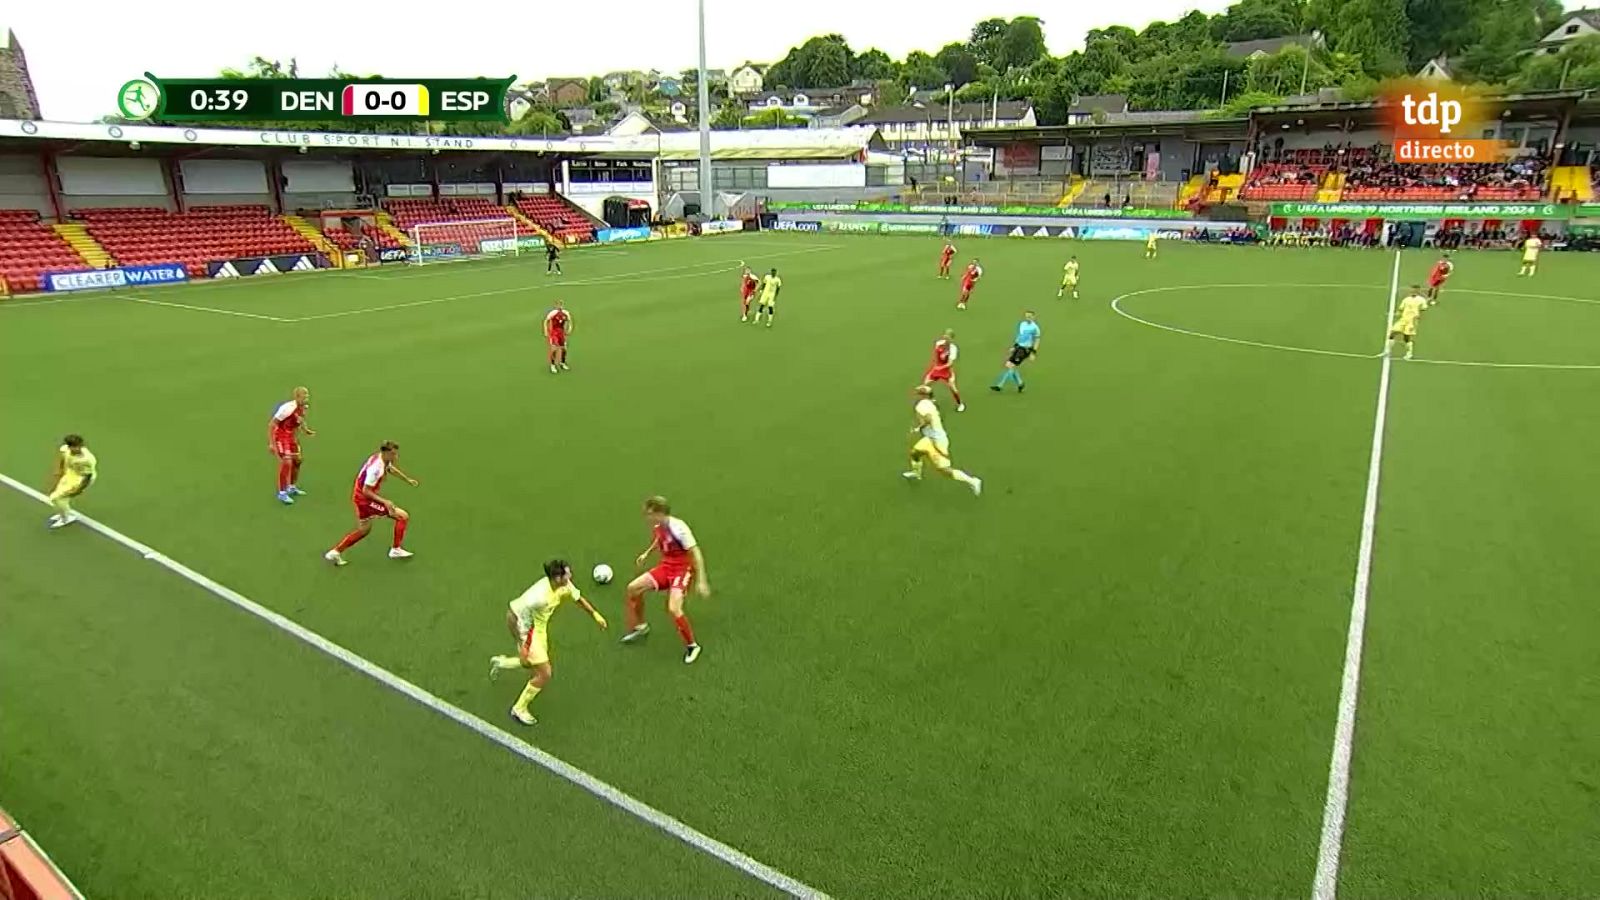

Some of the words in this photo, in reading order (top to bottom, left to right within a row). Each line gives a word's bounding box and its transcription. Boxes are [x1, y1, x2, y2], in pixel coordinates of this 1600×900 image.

[260, 132, 311, 145] CLUB
[323, 134, 380, 147] SPORT
[425, 138, 474, 149] STAND
[1297, 204, 1325, 213] UEFA
[1444, 206, 1500, 214] IRELAND
[1501, 206, 1535, 214] 2024
[380, 248, 406, 260] UEFA
[56, 272, 121, 289] CLEARER
[125, 269, 175, 282] WATER
